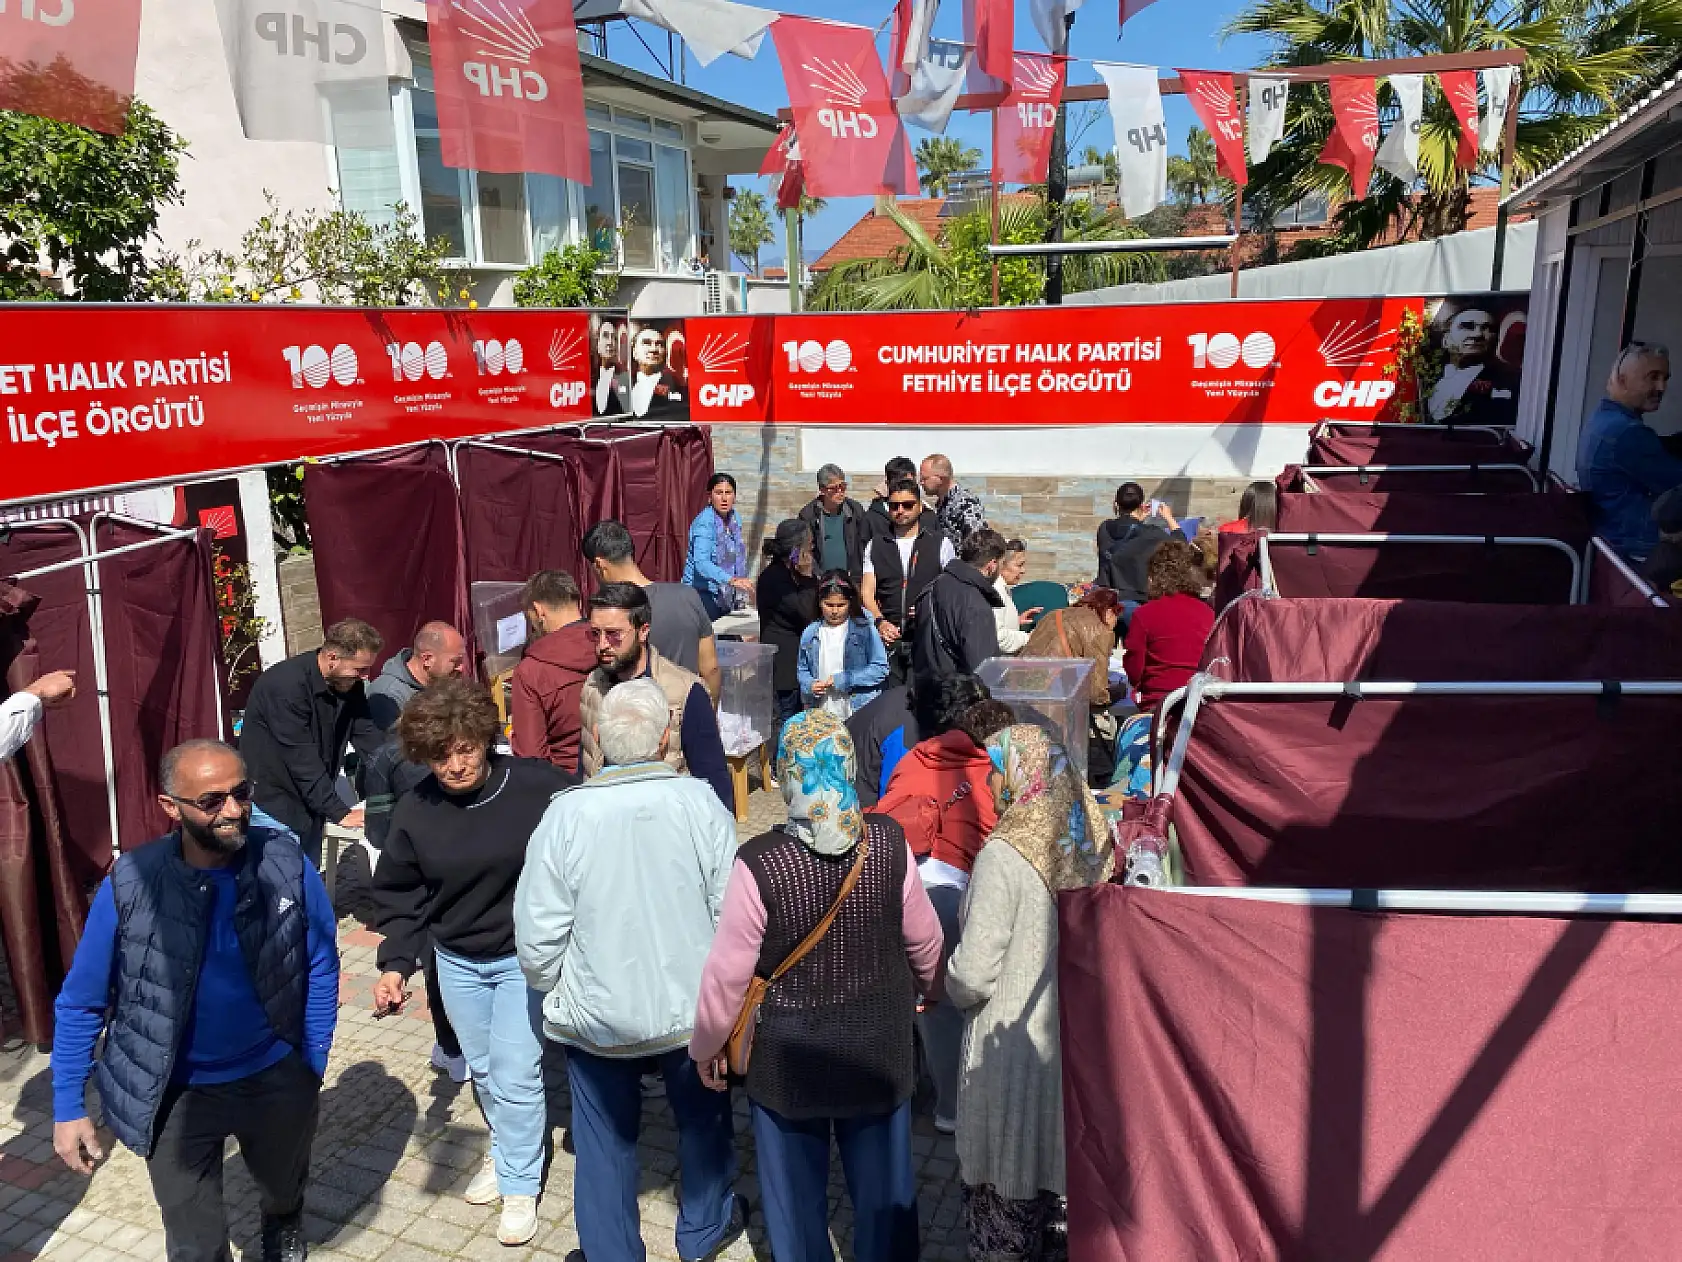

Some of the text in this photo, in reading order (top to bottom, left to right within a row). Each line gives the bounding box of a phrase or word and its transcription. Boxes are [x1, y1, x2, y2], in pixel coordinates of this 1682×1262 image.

[283, 344, 358, 388] 100
[386, 341, 447, 381] 100
[473, 338, 524, 376] 100
[781, 339, 853, 373] 100
[877, 336, 1162, 364] CUMHURİYET HALK PARTİSİ
[1187, 331, 1276, 369] 100
[44, 360, 128, 393] HALK
[133, 350, 232, 388] PARTİSİ
[902, 367, 1132, 397] FETHİYE İLÇE ÖRGÜTÜ
[550, 381, 586, 407] CHP
[699, 383, 756, 408] CHP
[1313, 380, 1396, 408] CHP
[6, 394, 205, 448] İLÇE ÖRGÜTÜ
